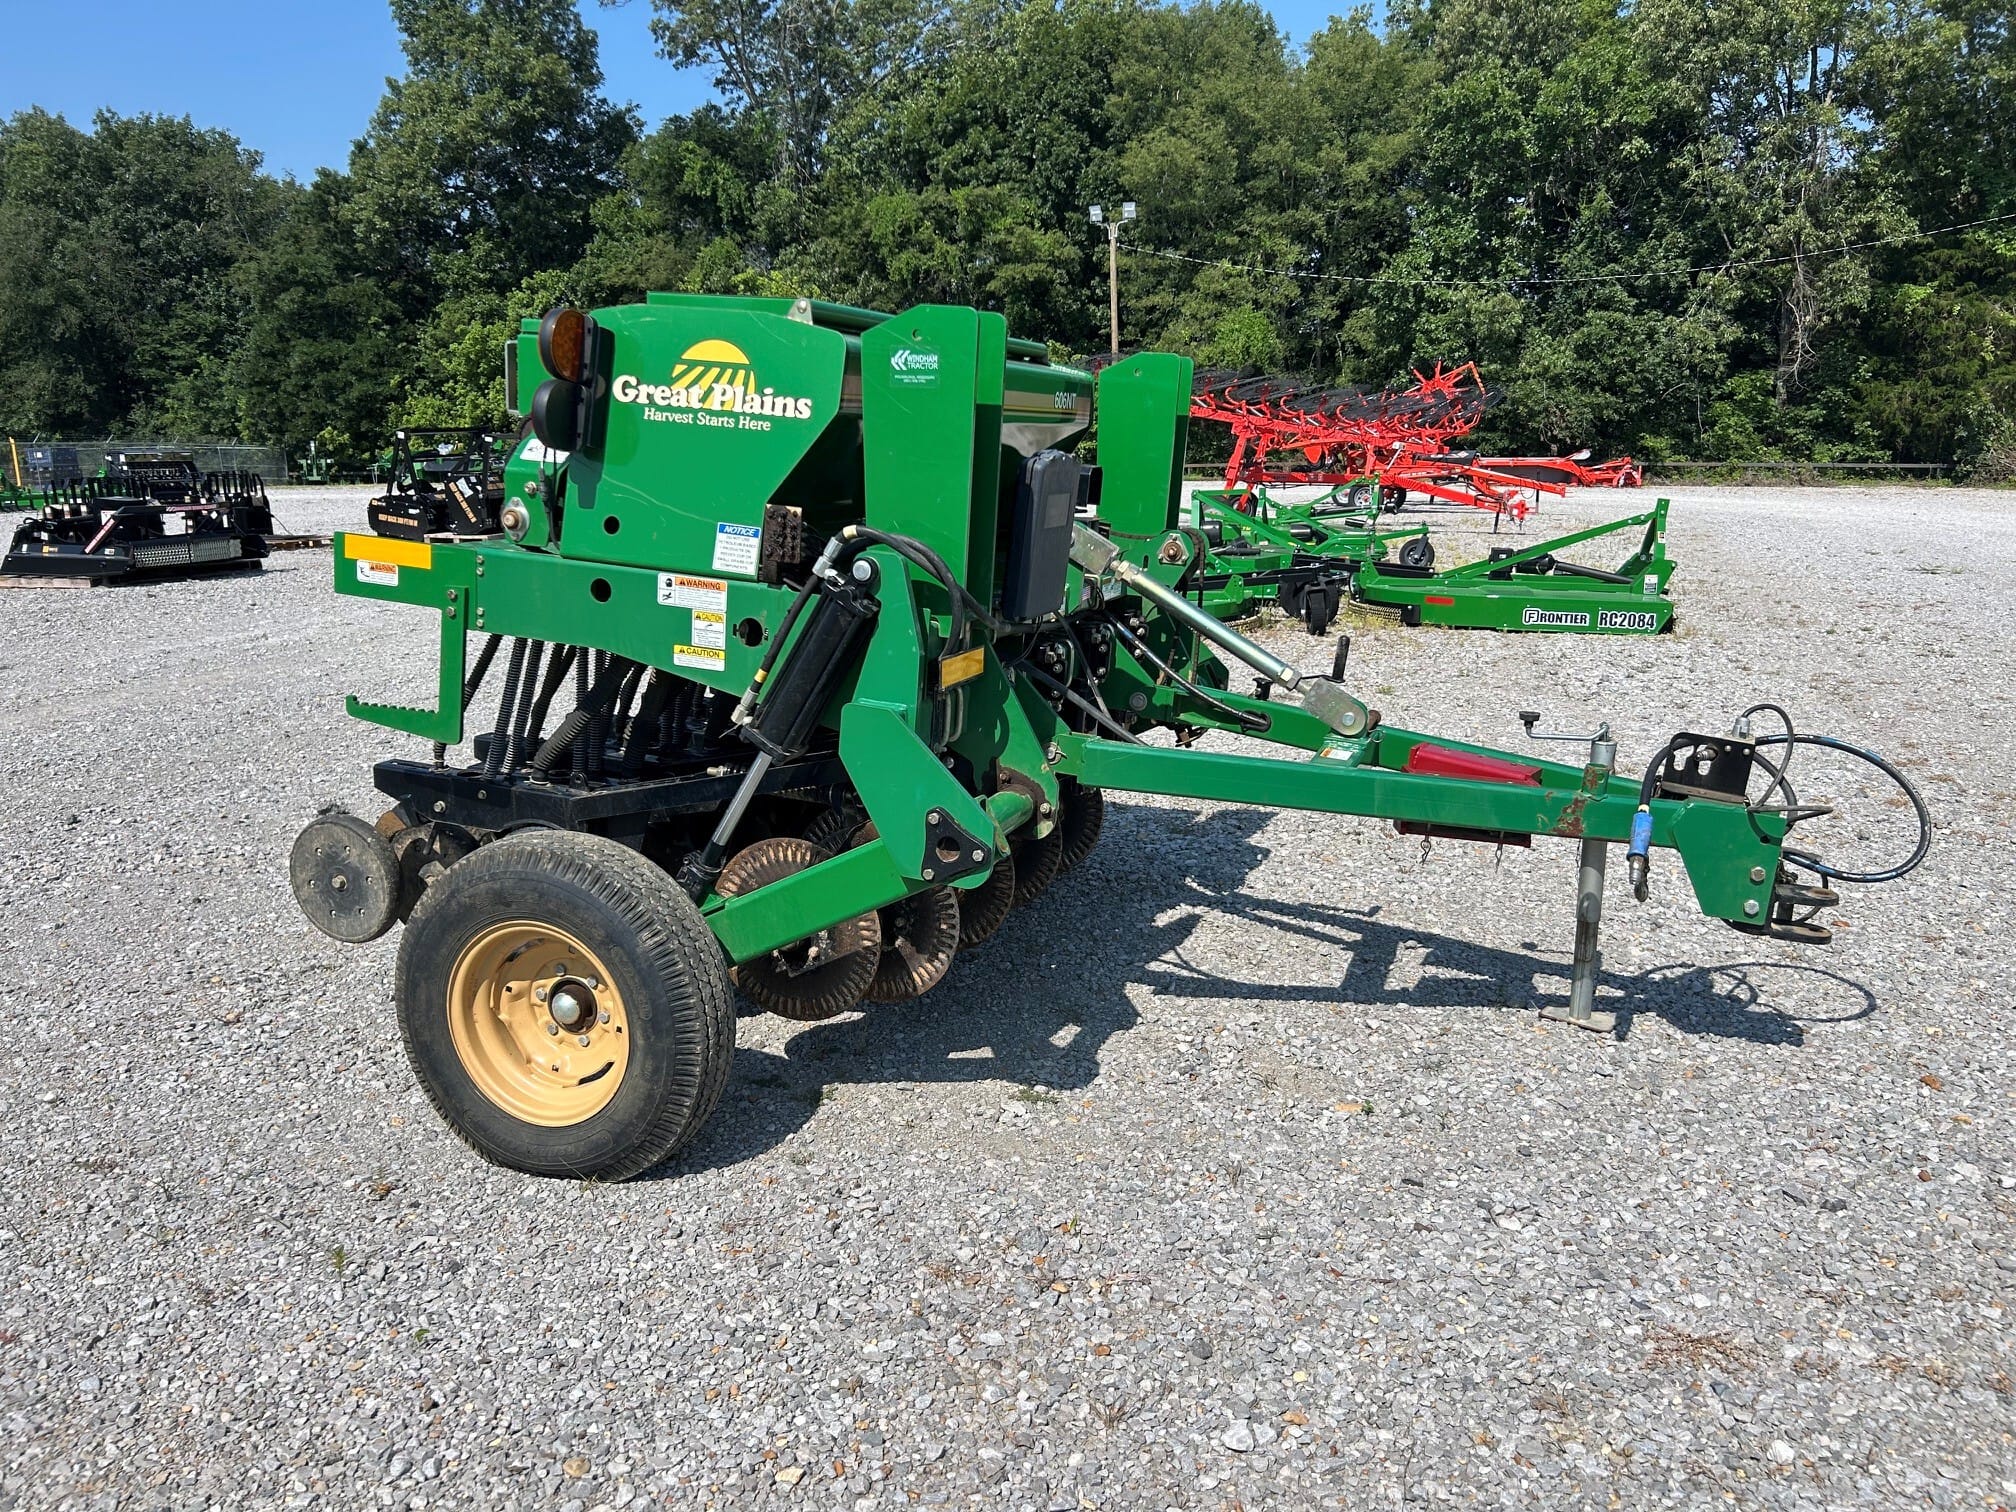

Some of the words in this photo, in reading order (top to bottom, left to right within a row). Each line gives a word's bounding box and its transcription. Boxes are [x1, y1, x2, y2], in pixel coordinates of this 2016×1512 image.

[907, 354, 938, 363] WINDHAM
[907, 362, 938, 370] TRACTOR
[612, 374, 704, 410] Great
[711, 382, 813, 419] Plains
[1054, 391, 1077, 409] 606NT
[643, 406, 694, 425] Harvest
[696, 411, 735, 429] Starts
[739, 415, 771, 431] Here
[723, 525, 757, 537] NOTICE
[686, 579, 721, 590] WARNING
[701, 613, 723, 622] CAUTION
[1524, 609, 1588, 625] FRONTIER
[1598, 612, 1655, 629] RC2084
[686, 647, 720, 658] CAUTION
